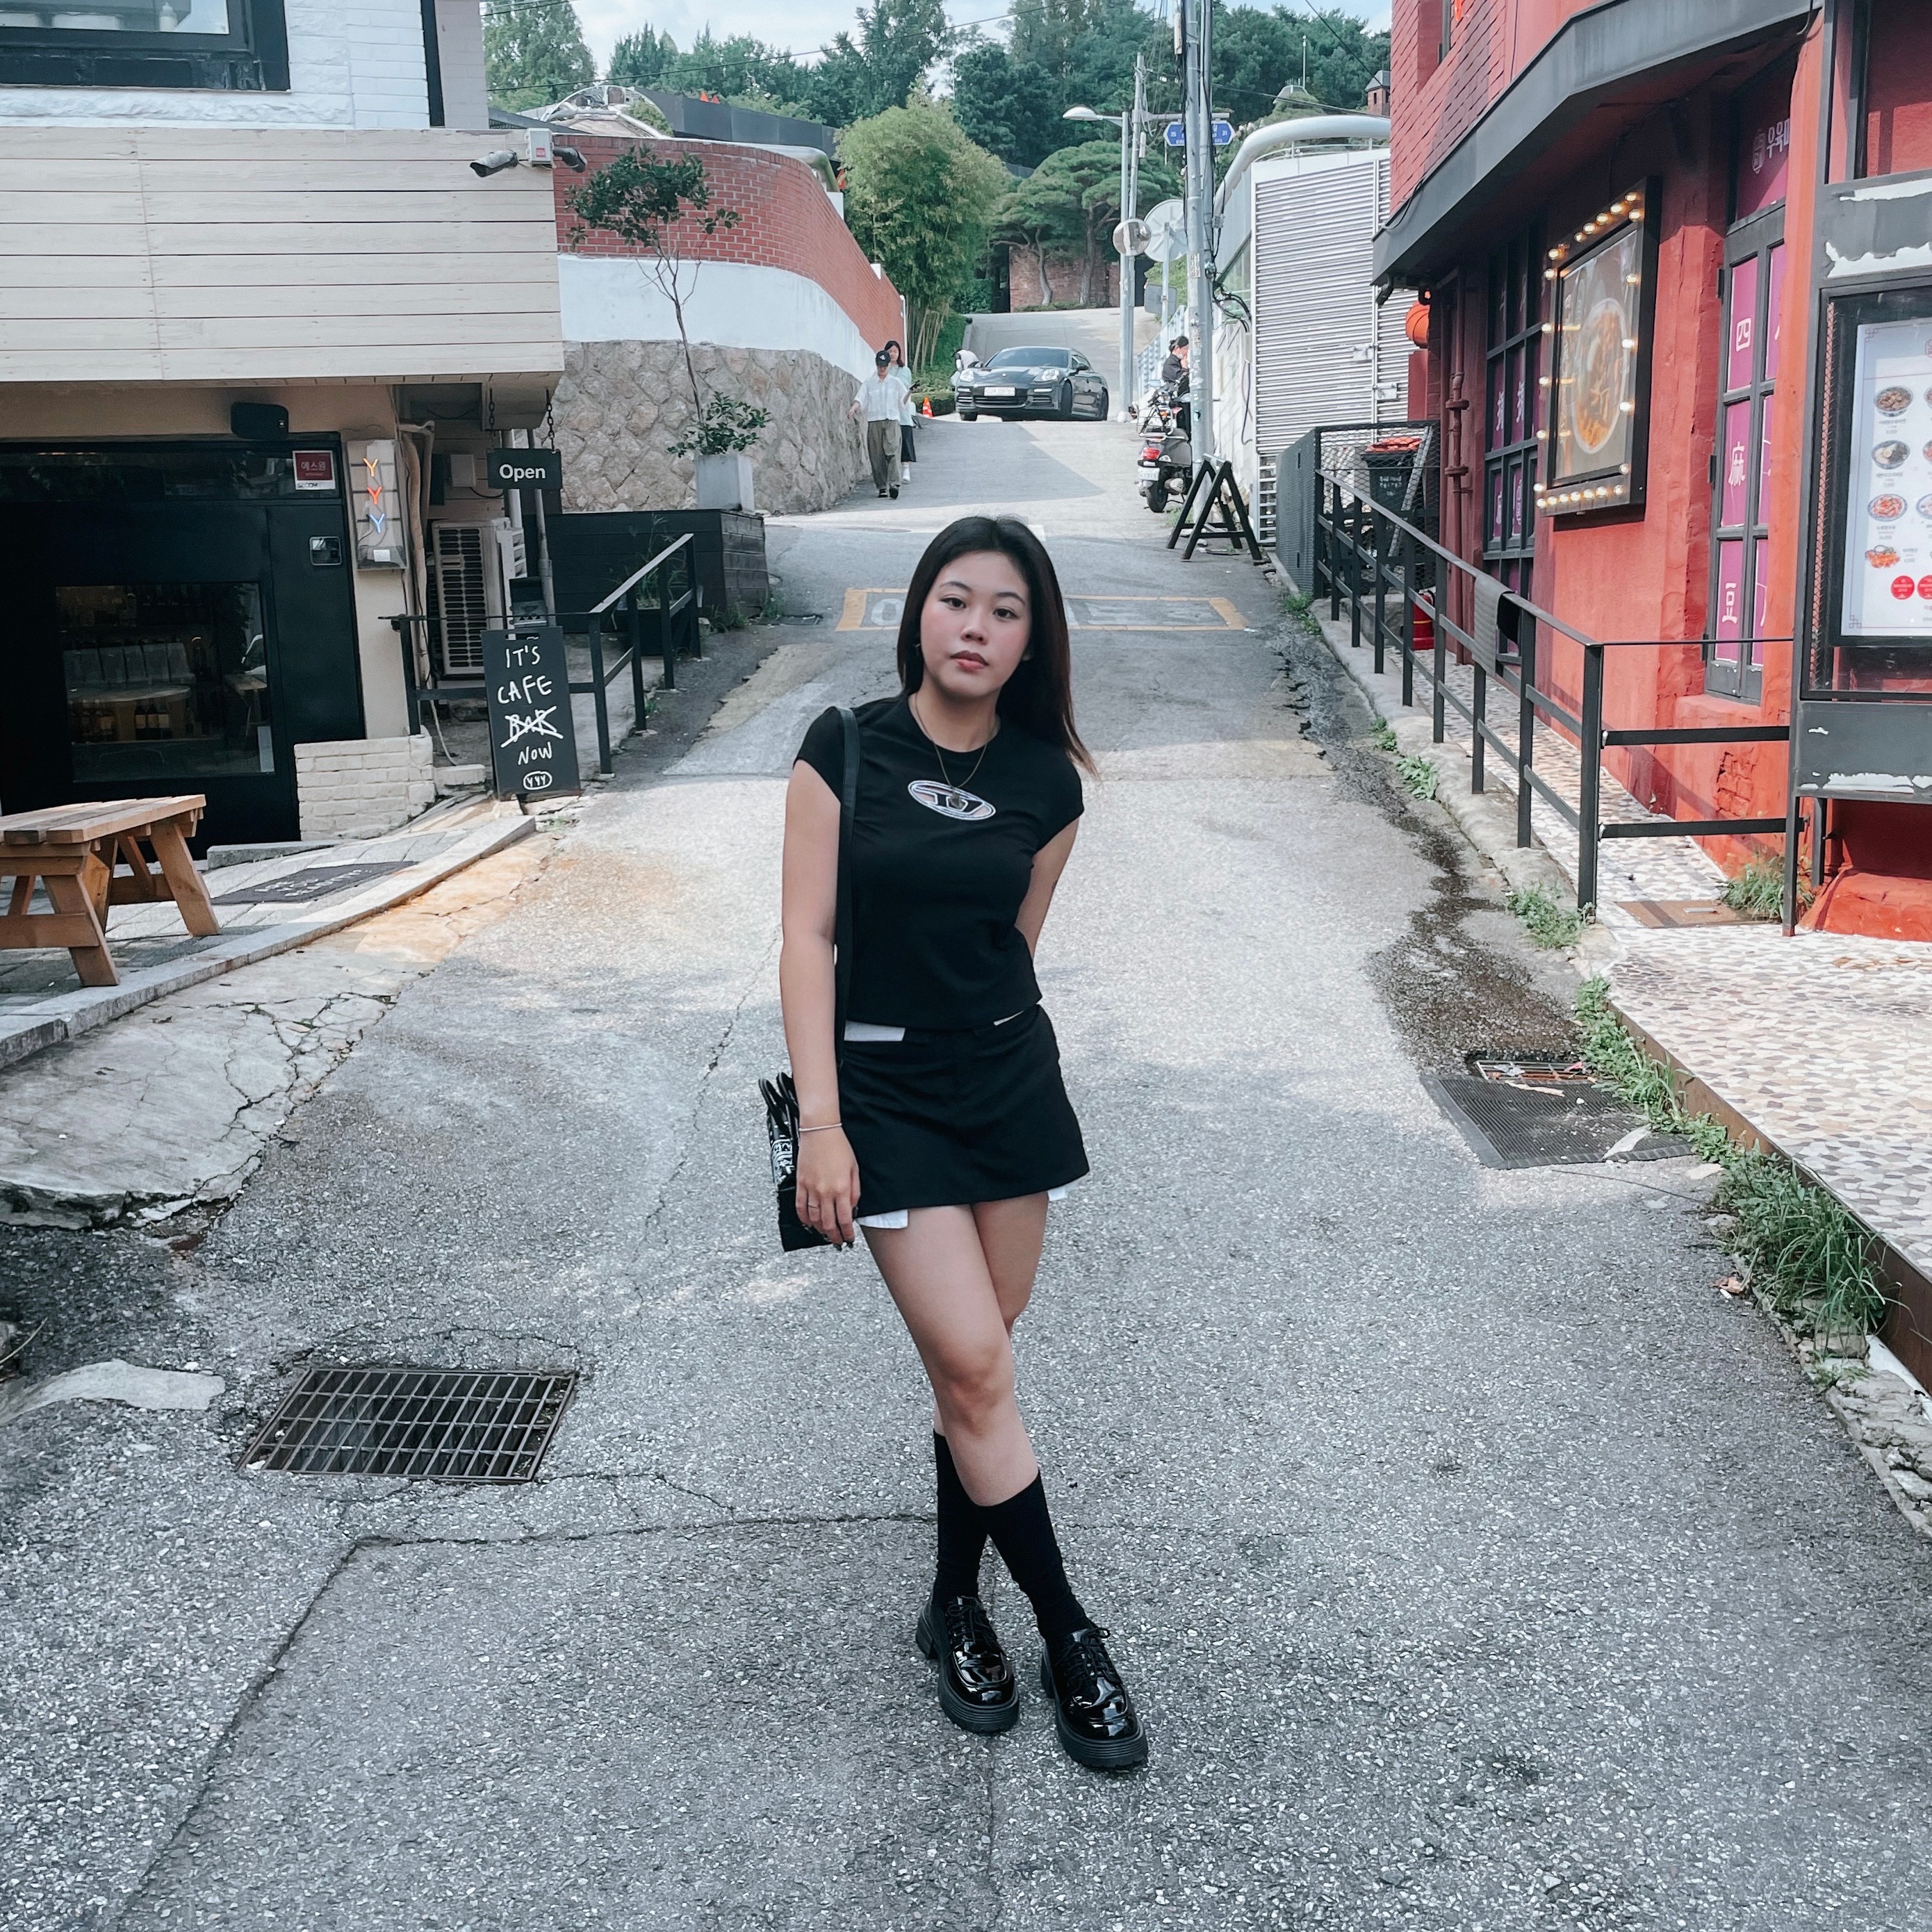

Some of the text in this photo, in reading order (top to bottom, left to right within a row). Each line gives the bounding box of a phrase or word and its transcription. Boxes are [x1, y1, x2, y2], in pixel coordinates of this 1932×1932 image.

[1735, 317, 1752, 352] 四
[499, 464, 546, 482] Open
[505, 645, 541, 669] IT'S
[497, 675, 552, 705] CAFE
